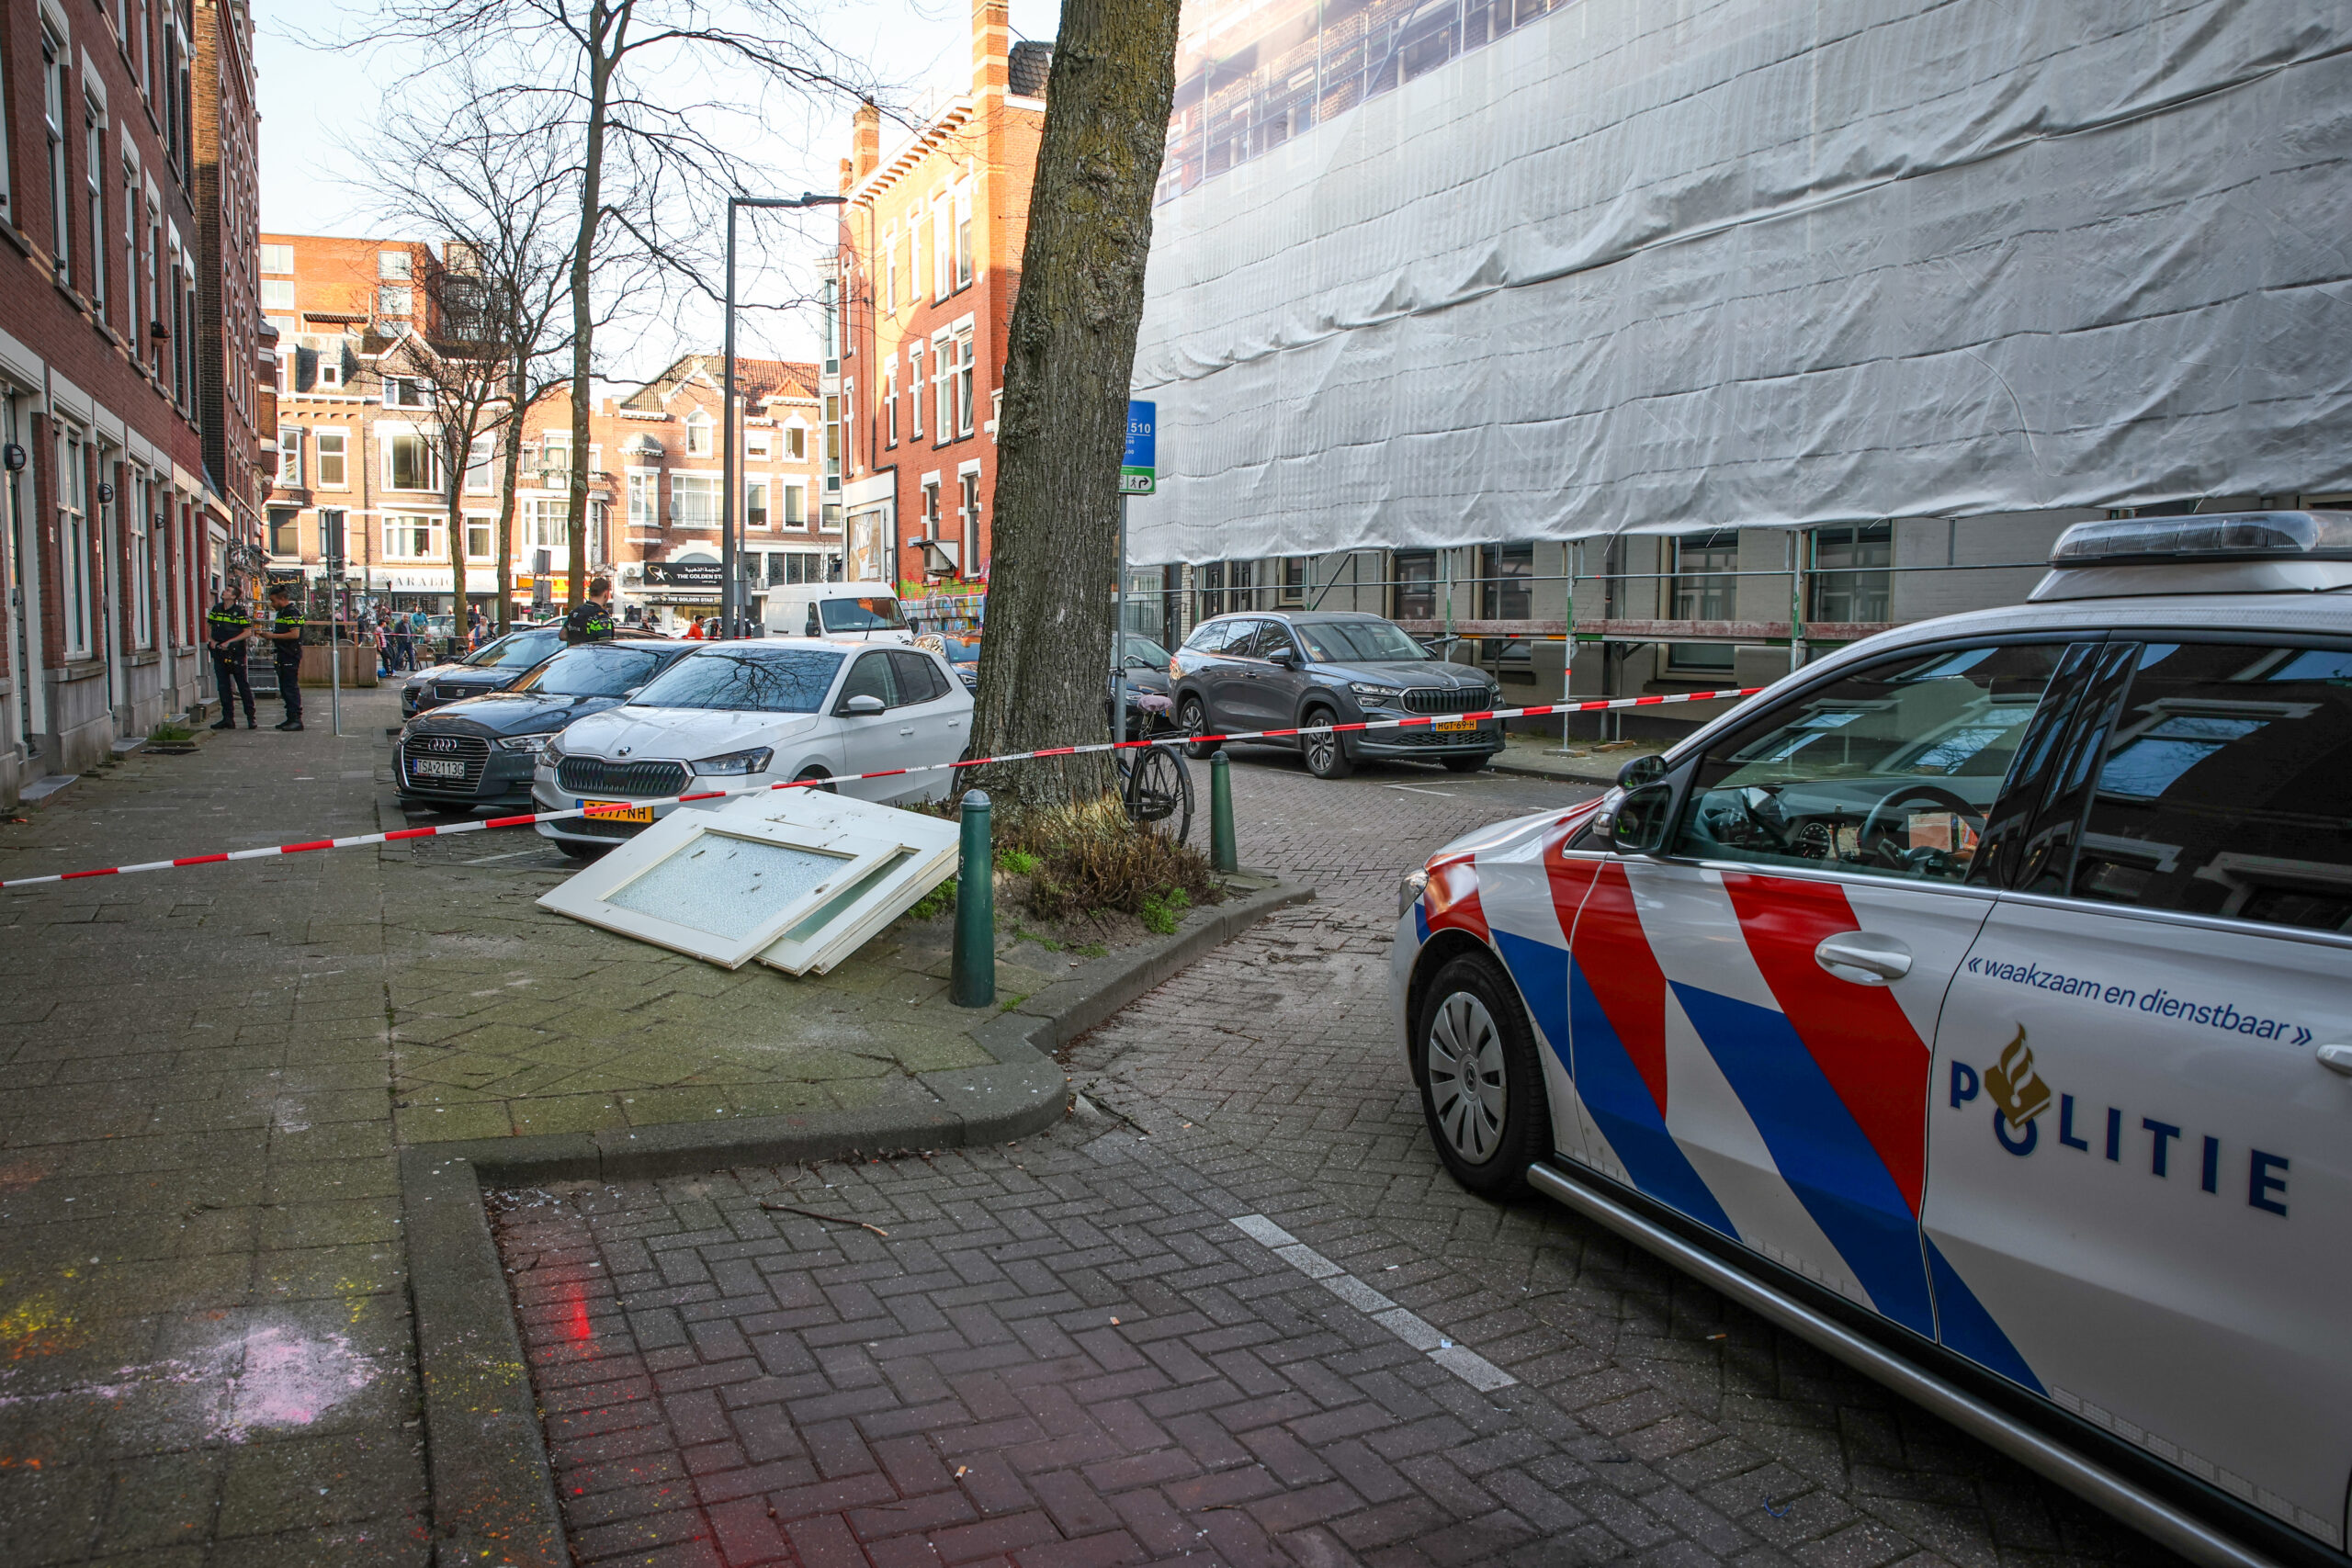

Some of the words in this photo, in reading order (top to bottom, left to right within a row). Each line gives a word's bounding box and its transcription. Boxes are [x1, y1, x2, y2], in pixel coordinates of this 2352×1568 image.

[1126, 422, 1151, 434] 510
[2104, 985, 2135, 1008] en
[1950, 1059, 2290, 1218] POLITIE
